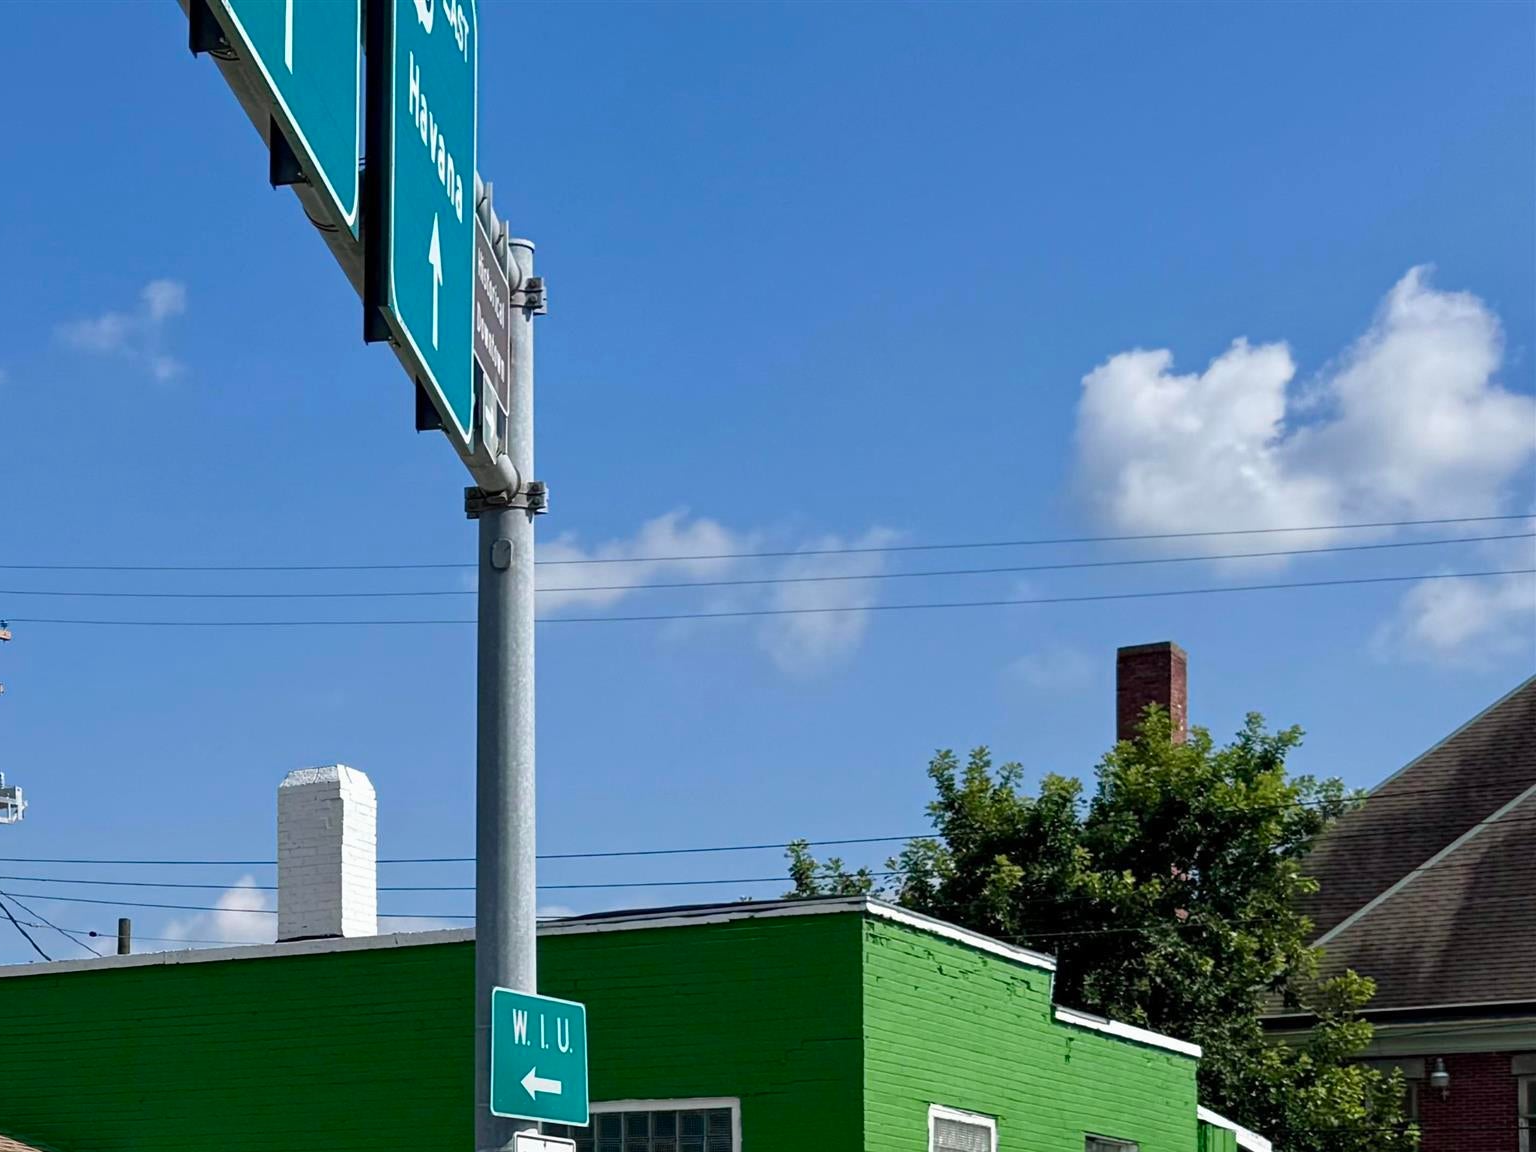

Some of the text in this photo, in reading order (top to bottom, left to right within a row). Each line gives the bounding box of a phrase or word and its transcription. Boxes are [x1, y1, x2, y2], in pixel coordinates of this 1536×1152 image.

[409, 51, 463, 224] Havana
[513, 1008, 531, 1046] W.
[557, 1017, 573, 1053] U.
